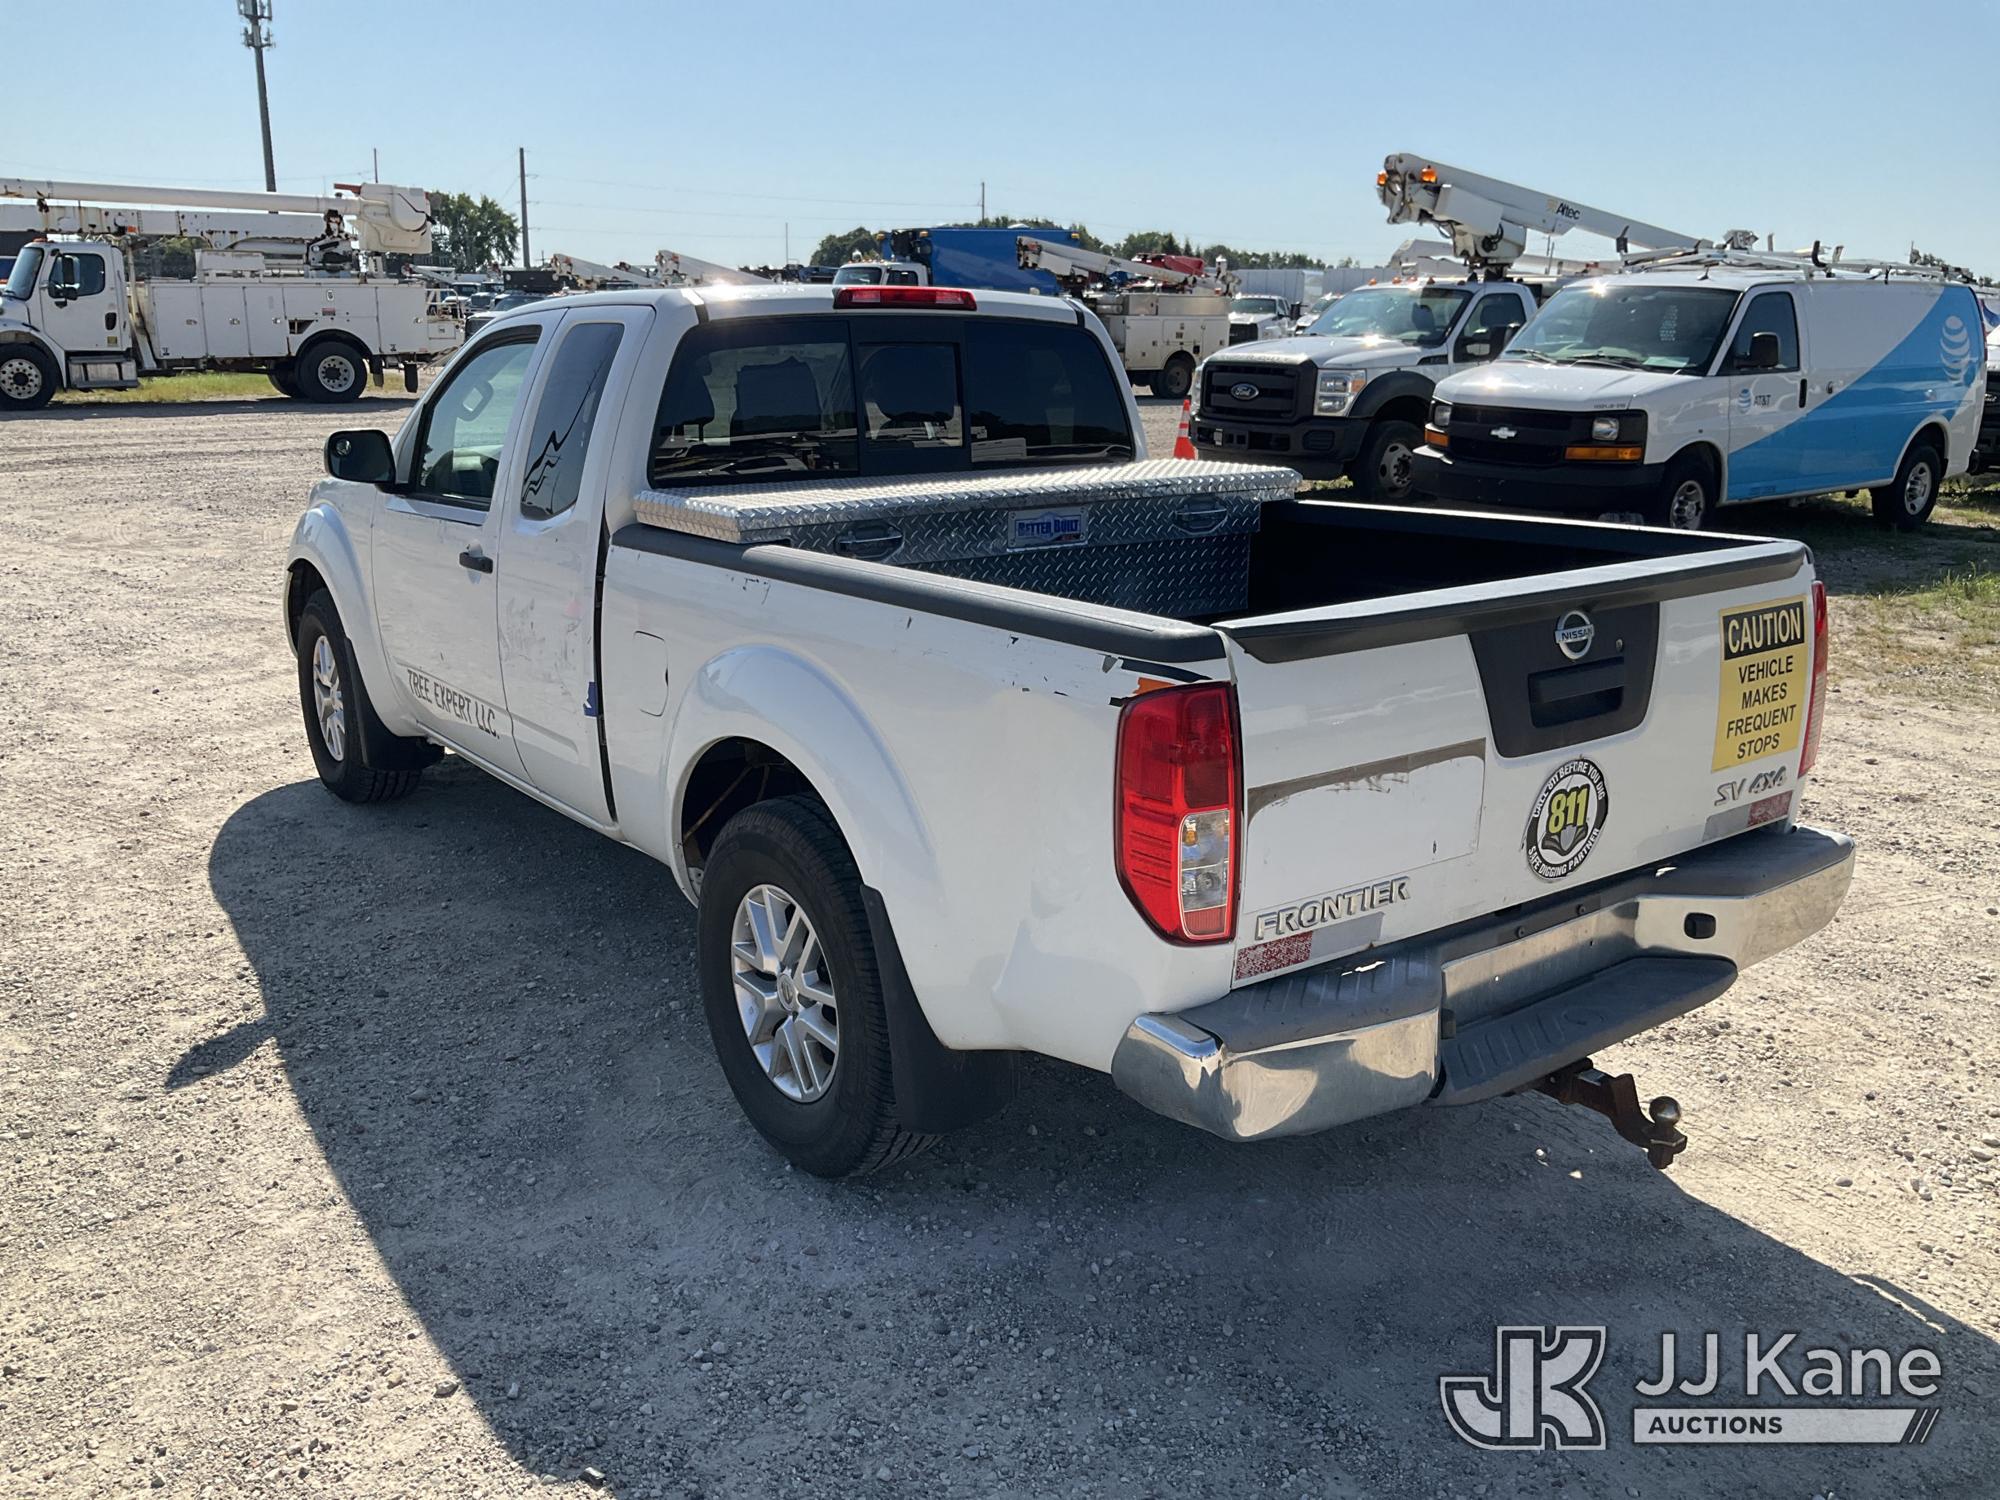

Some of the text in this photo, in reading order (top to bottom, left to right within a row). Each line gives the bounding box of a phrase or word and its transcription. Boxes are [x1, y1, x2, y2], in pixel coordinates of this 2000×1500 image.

[1556, 203, 1581, 220] Altec
[1561, 627, 1593, 641] NISSAN
[1728, 607, 1801, 654] CAUTION
[1738, 655, 1794, 684] VEHICLE
[407, 669, 433, 704] TREE
[434, 681, 472, 724] EXPERT
[1741, 682, 1787, 710] MAKES
[1726, 704, 1797, 739] FREQUENT
[1737, 733, 1780, 760] STOPS
[1533, 787, 1549, 818] CALL
[1559, 761, 1589, 779] BEFORE
[1588, 765, 1601, 783] YOU
[1597, 781, 1606, 801] DIG
[1714, 778, 1747, 806] SV
[1548, 787, 1589, 834] 811
[1528, 828, 1600, 878] SAFE DIGGING PARTNER
[1255, 876, 1411, 940] FRONTIER
